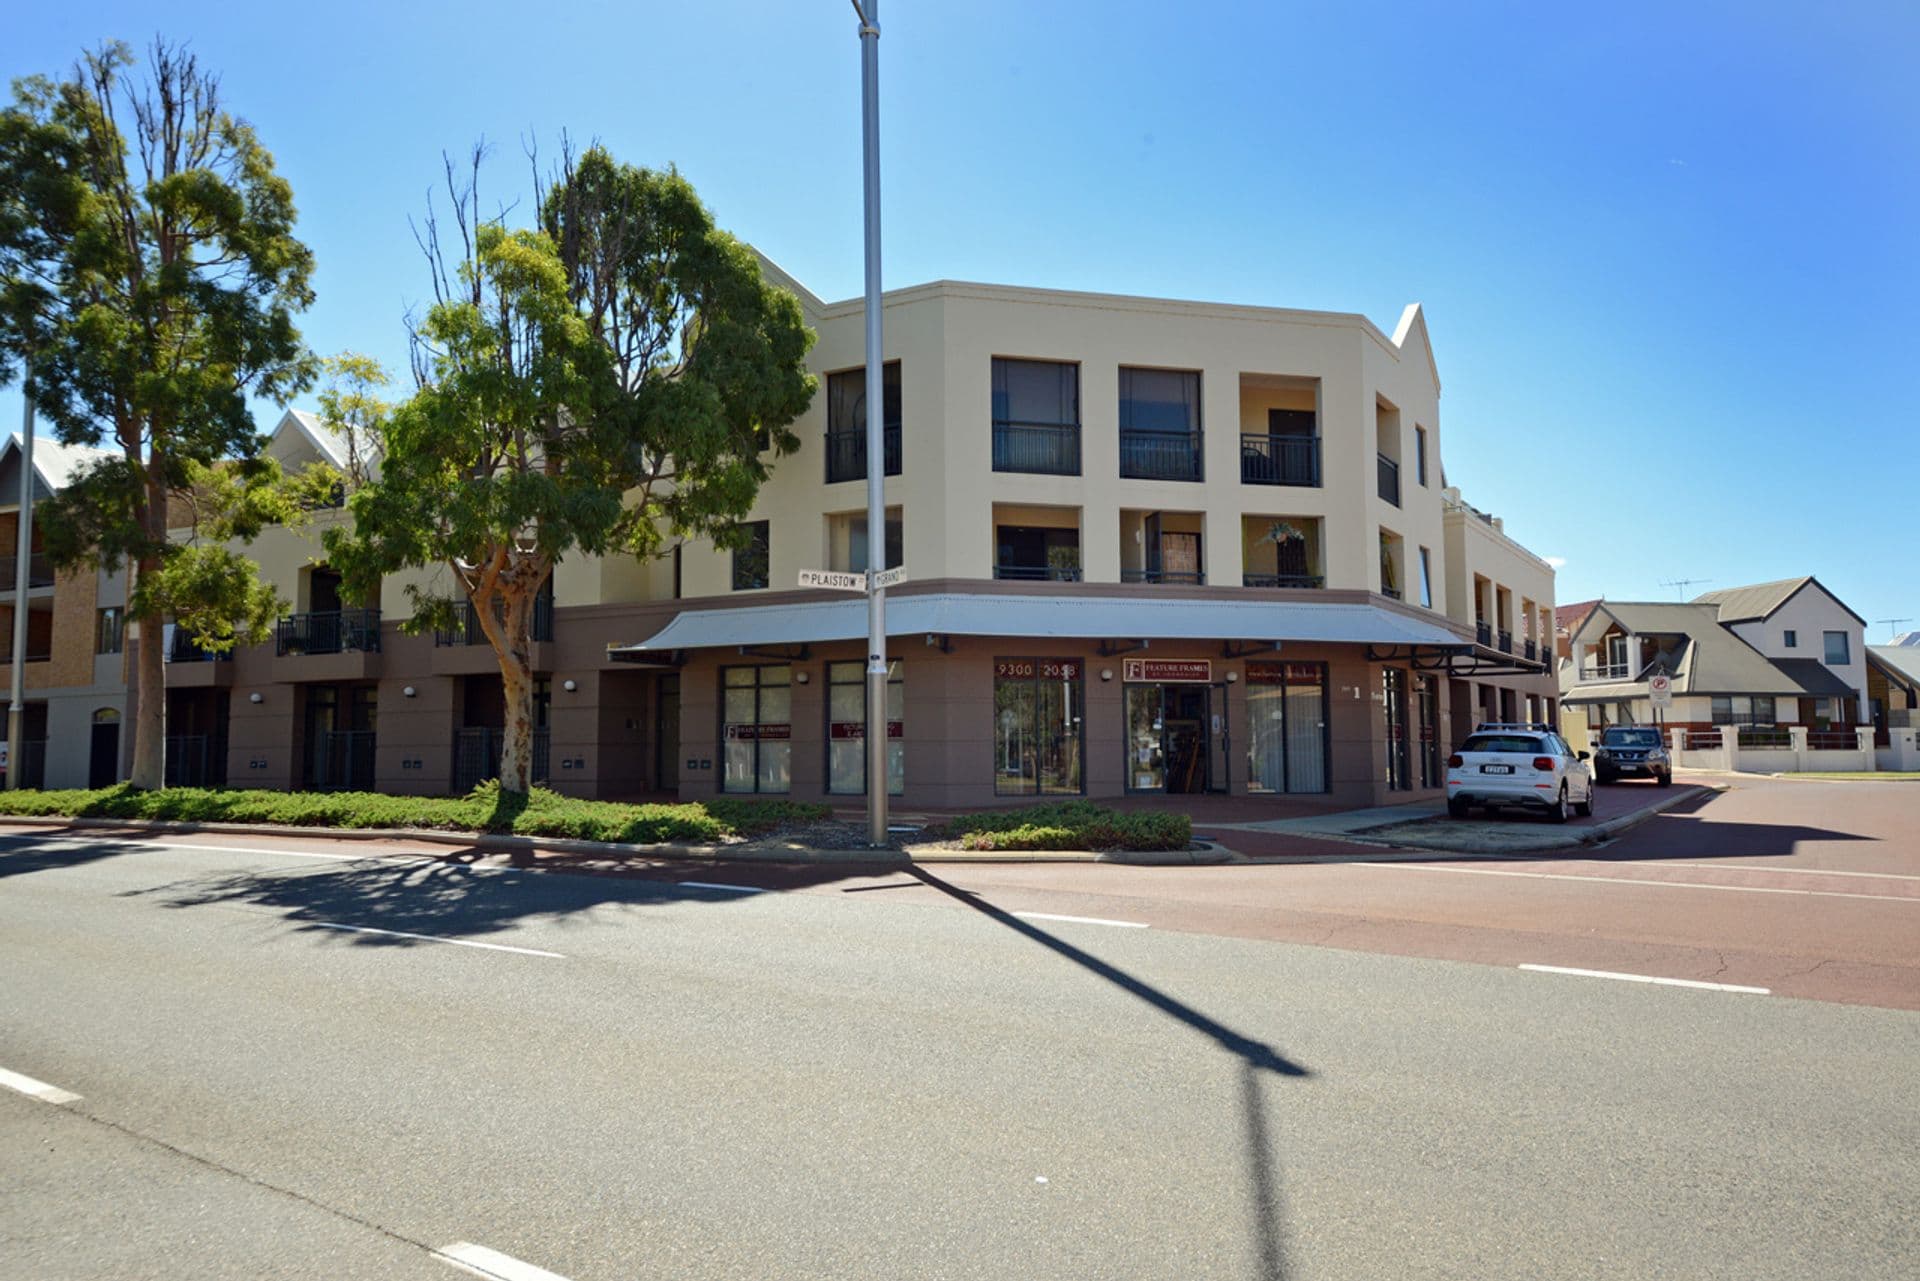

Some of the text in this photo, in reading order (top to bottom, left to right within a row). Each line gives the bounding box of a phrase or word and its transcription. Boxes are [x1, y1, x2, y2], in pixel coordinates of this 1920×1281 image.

[811, 573, 857, 587] PLAISTOW
[999, 664, 1032, 675] 9300
[1145, 664, 1208, 672] FEATURE FRAMES
